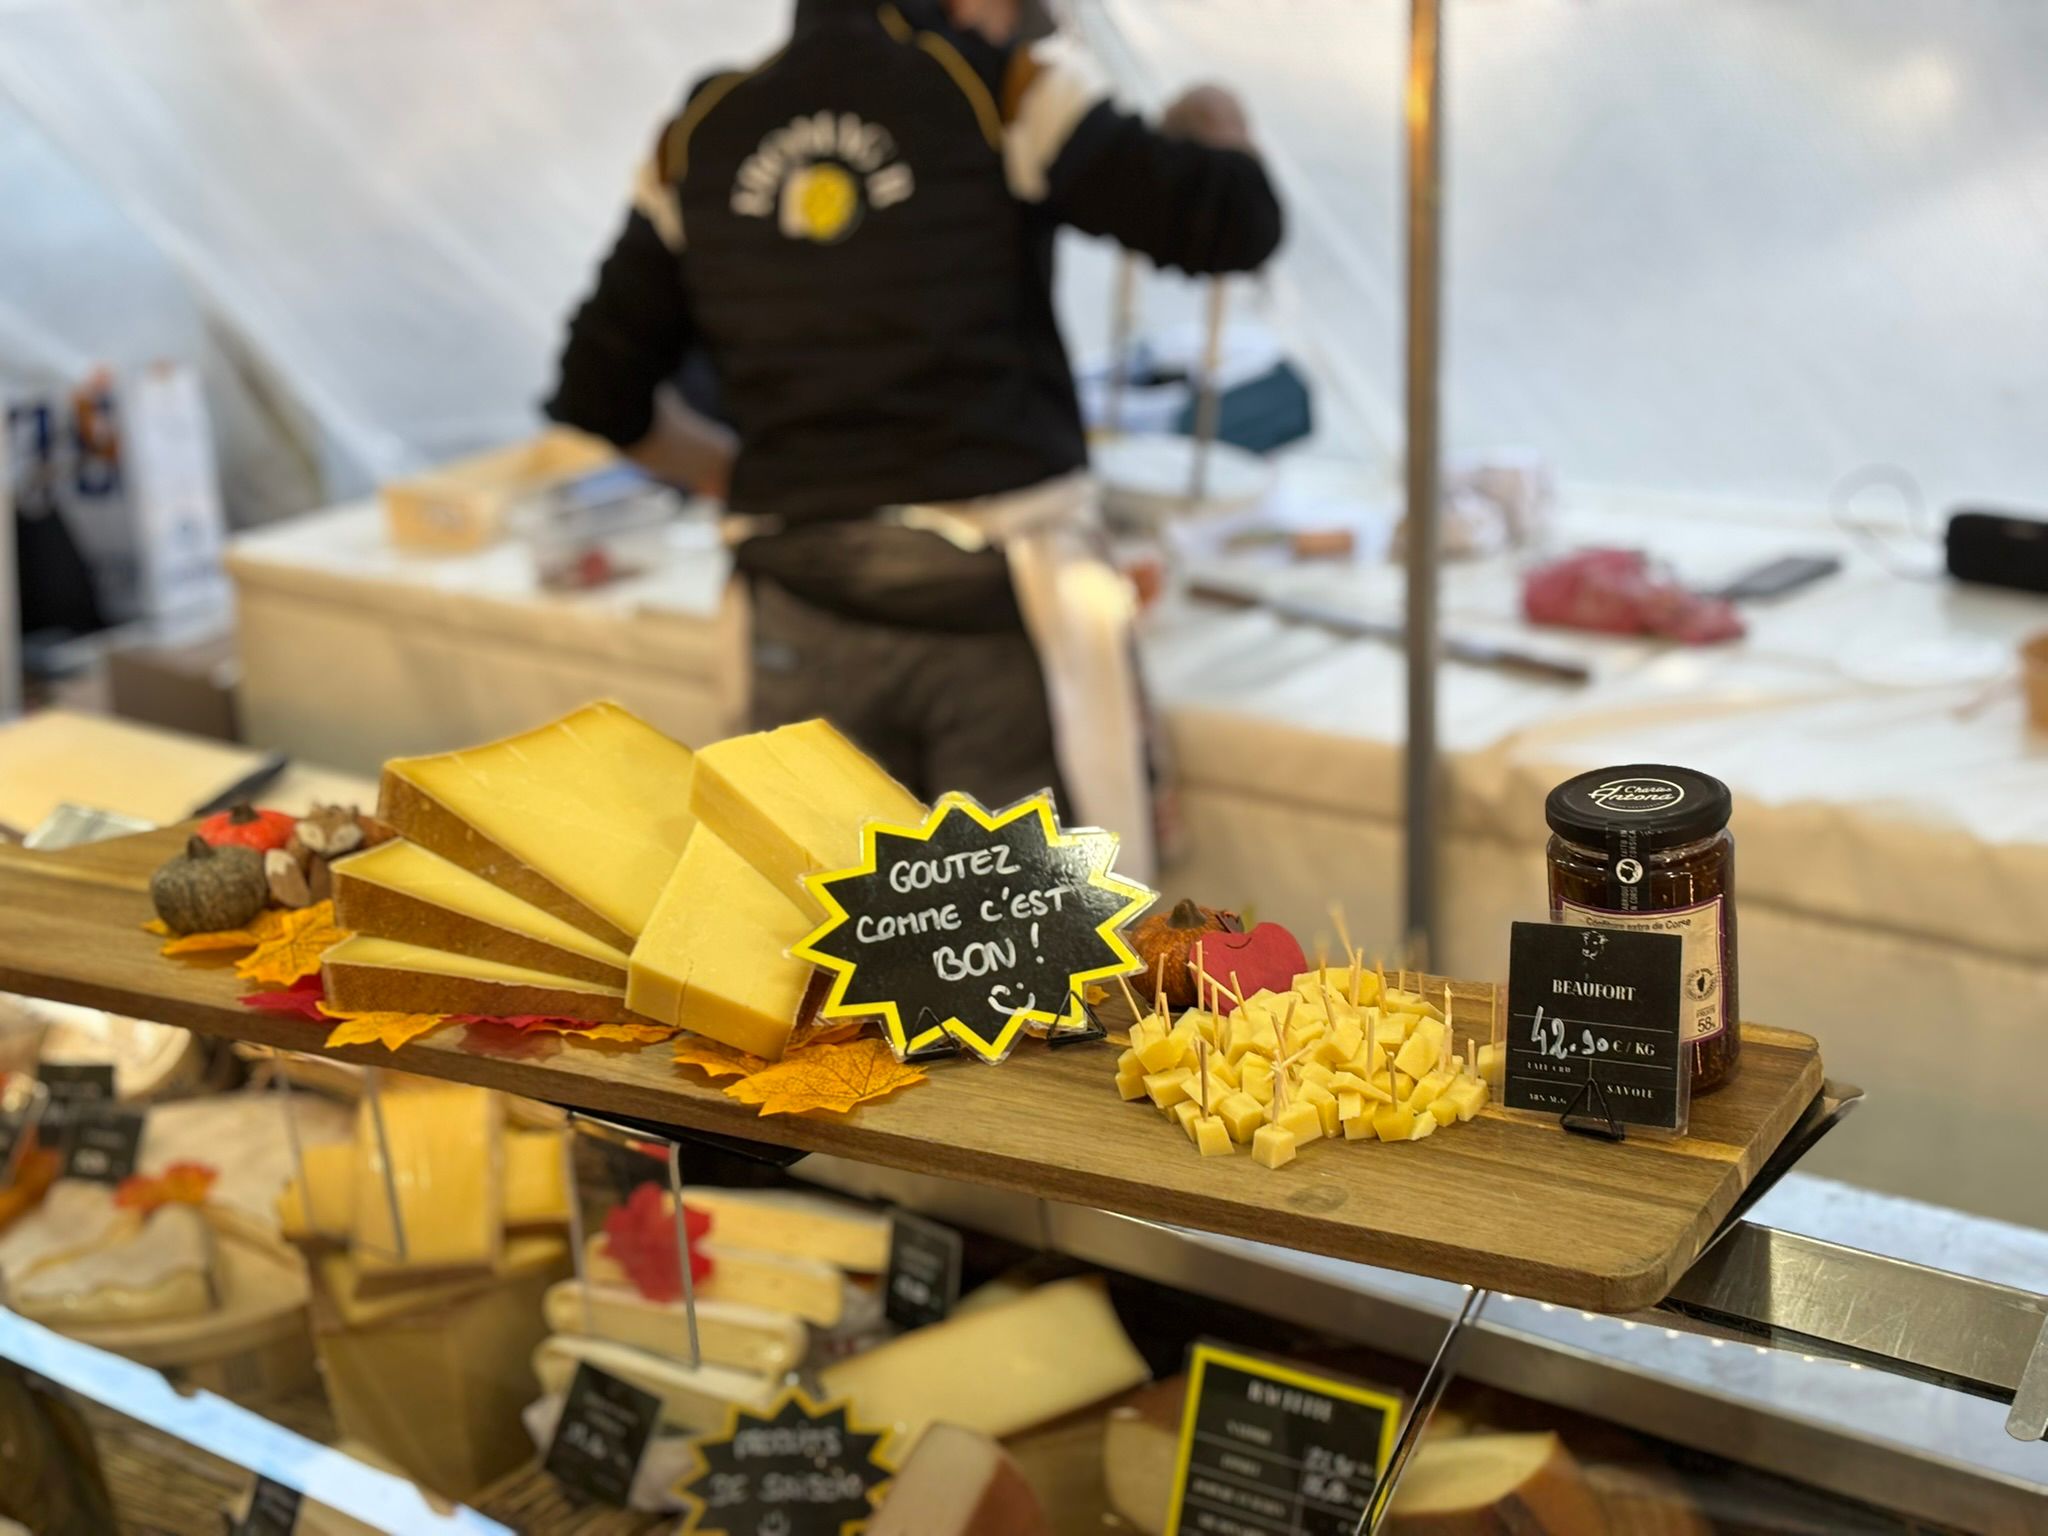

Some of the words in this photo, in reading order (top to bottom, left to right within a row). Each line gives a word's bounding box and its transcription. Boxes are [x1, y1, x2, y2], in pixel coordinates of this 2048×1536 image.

[889, 844, 1022, 894] GOUTEZ
[980, 886, 1070, 922] C'EST
[1652, 921, 1663, 930] de
[1666, 918, 1691, 930] Corse
[932, 937, 1017, 981] BON
[1552, 979, 1637, 1001] BEAUFORT
[1606, 1084, 1655, 1100] SAVOIE
